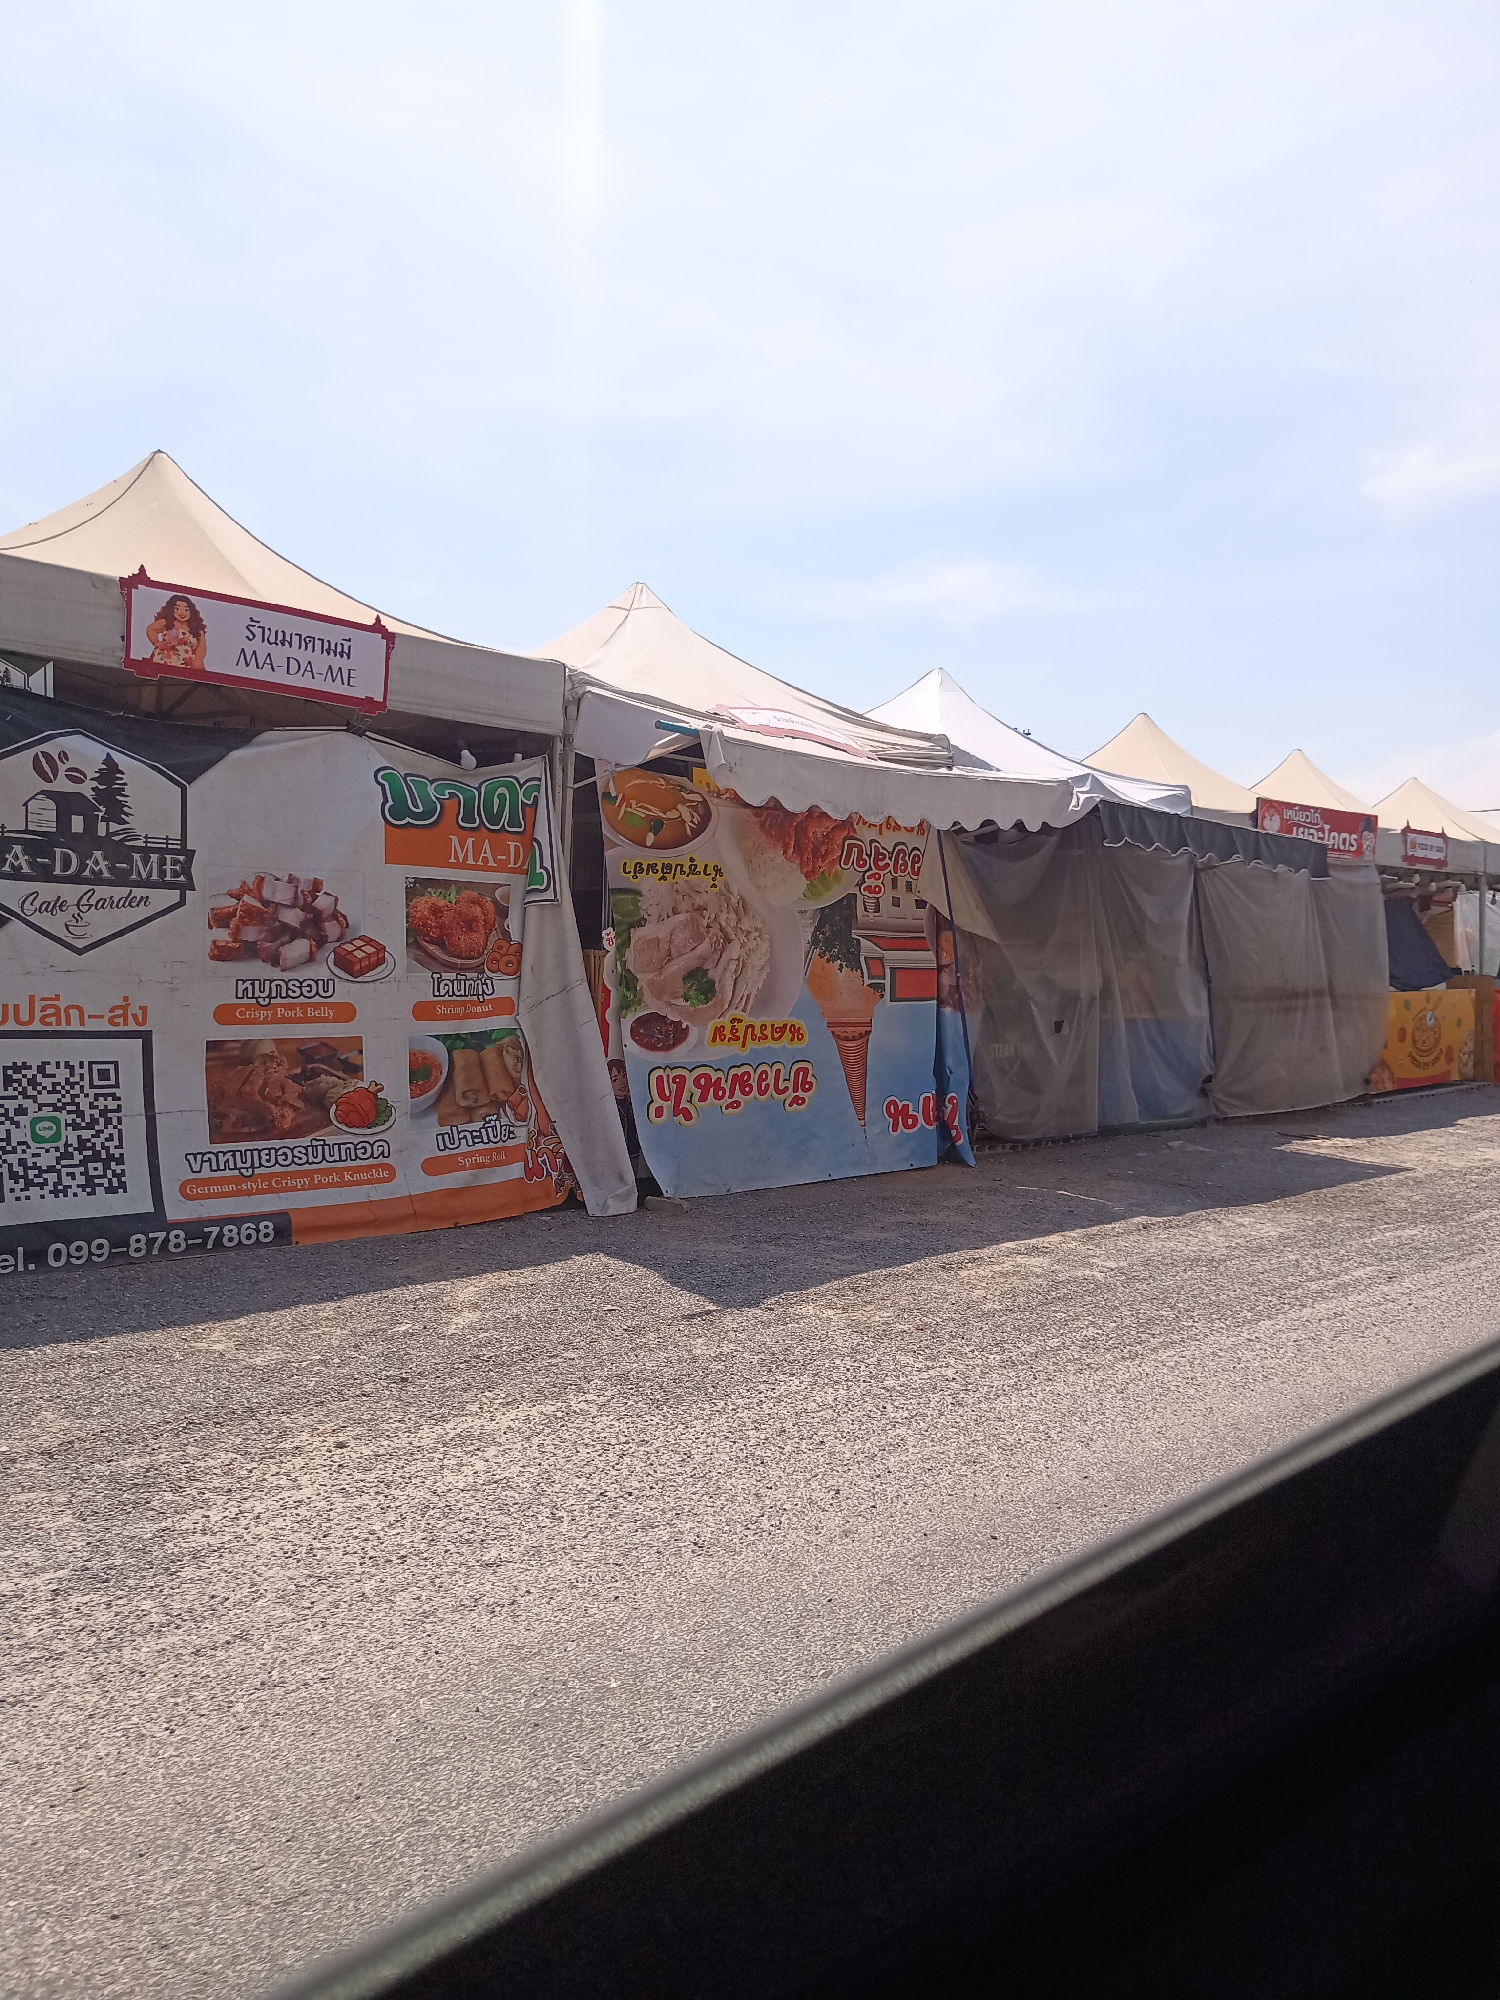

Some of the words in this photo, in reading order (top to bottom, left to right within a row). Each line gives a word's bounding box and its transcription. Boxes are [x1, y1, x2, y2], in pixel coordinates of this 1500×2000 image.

[235, 647, 357, 688] MA-DA-ME
[0, 844, 188, 884] A-DA-ME
[448, 835, 531, 870] MA-D
[18, 891, 68, 917] Cafe
[72, 888, 151, 914] Garden
[235, 977, 335, 1007] หมูกรอบ
[235, 1007, 274, 1021] Crispy
[276, 1006, 304, 1018] Pork
[306, 1005, 336, 1020] Belly
[435, 1004, 465, 1017] Shrimp
[465, 1003, 494, 1013] Donut
[186, 1138, 391, 1178] ขาหมูเยอรมันทอด
[457, 1155, 491, 1168] Spring
[491, 1152, 507, 1162] Roll
[186, 1178, 269, 1196] German-style
[271, 1176, 311, 1189] Crispy
[313, 1173, 342, 1185] Pork
[344, 1168, 390, 1183] Knuckle
[0, 1246, 36, 1274] el.
[47, 1220, 276, 1268] 099-878-7868
